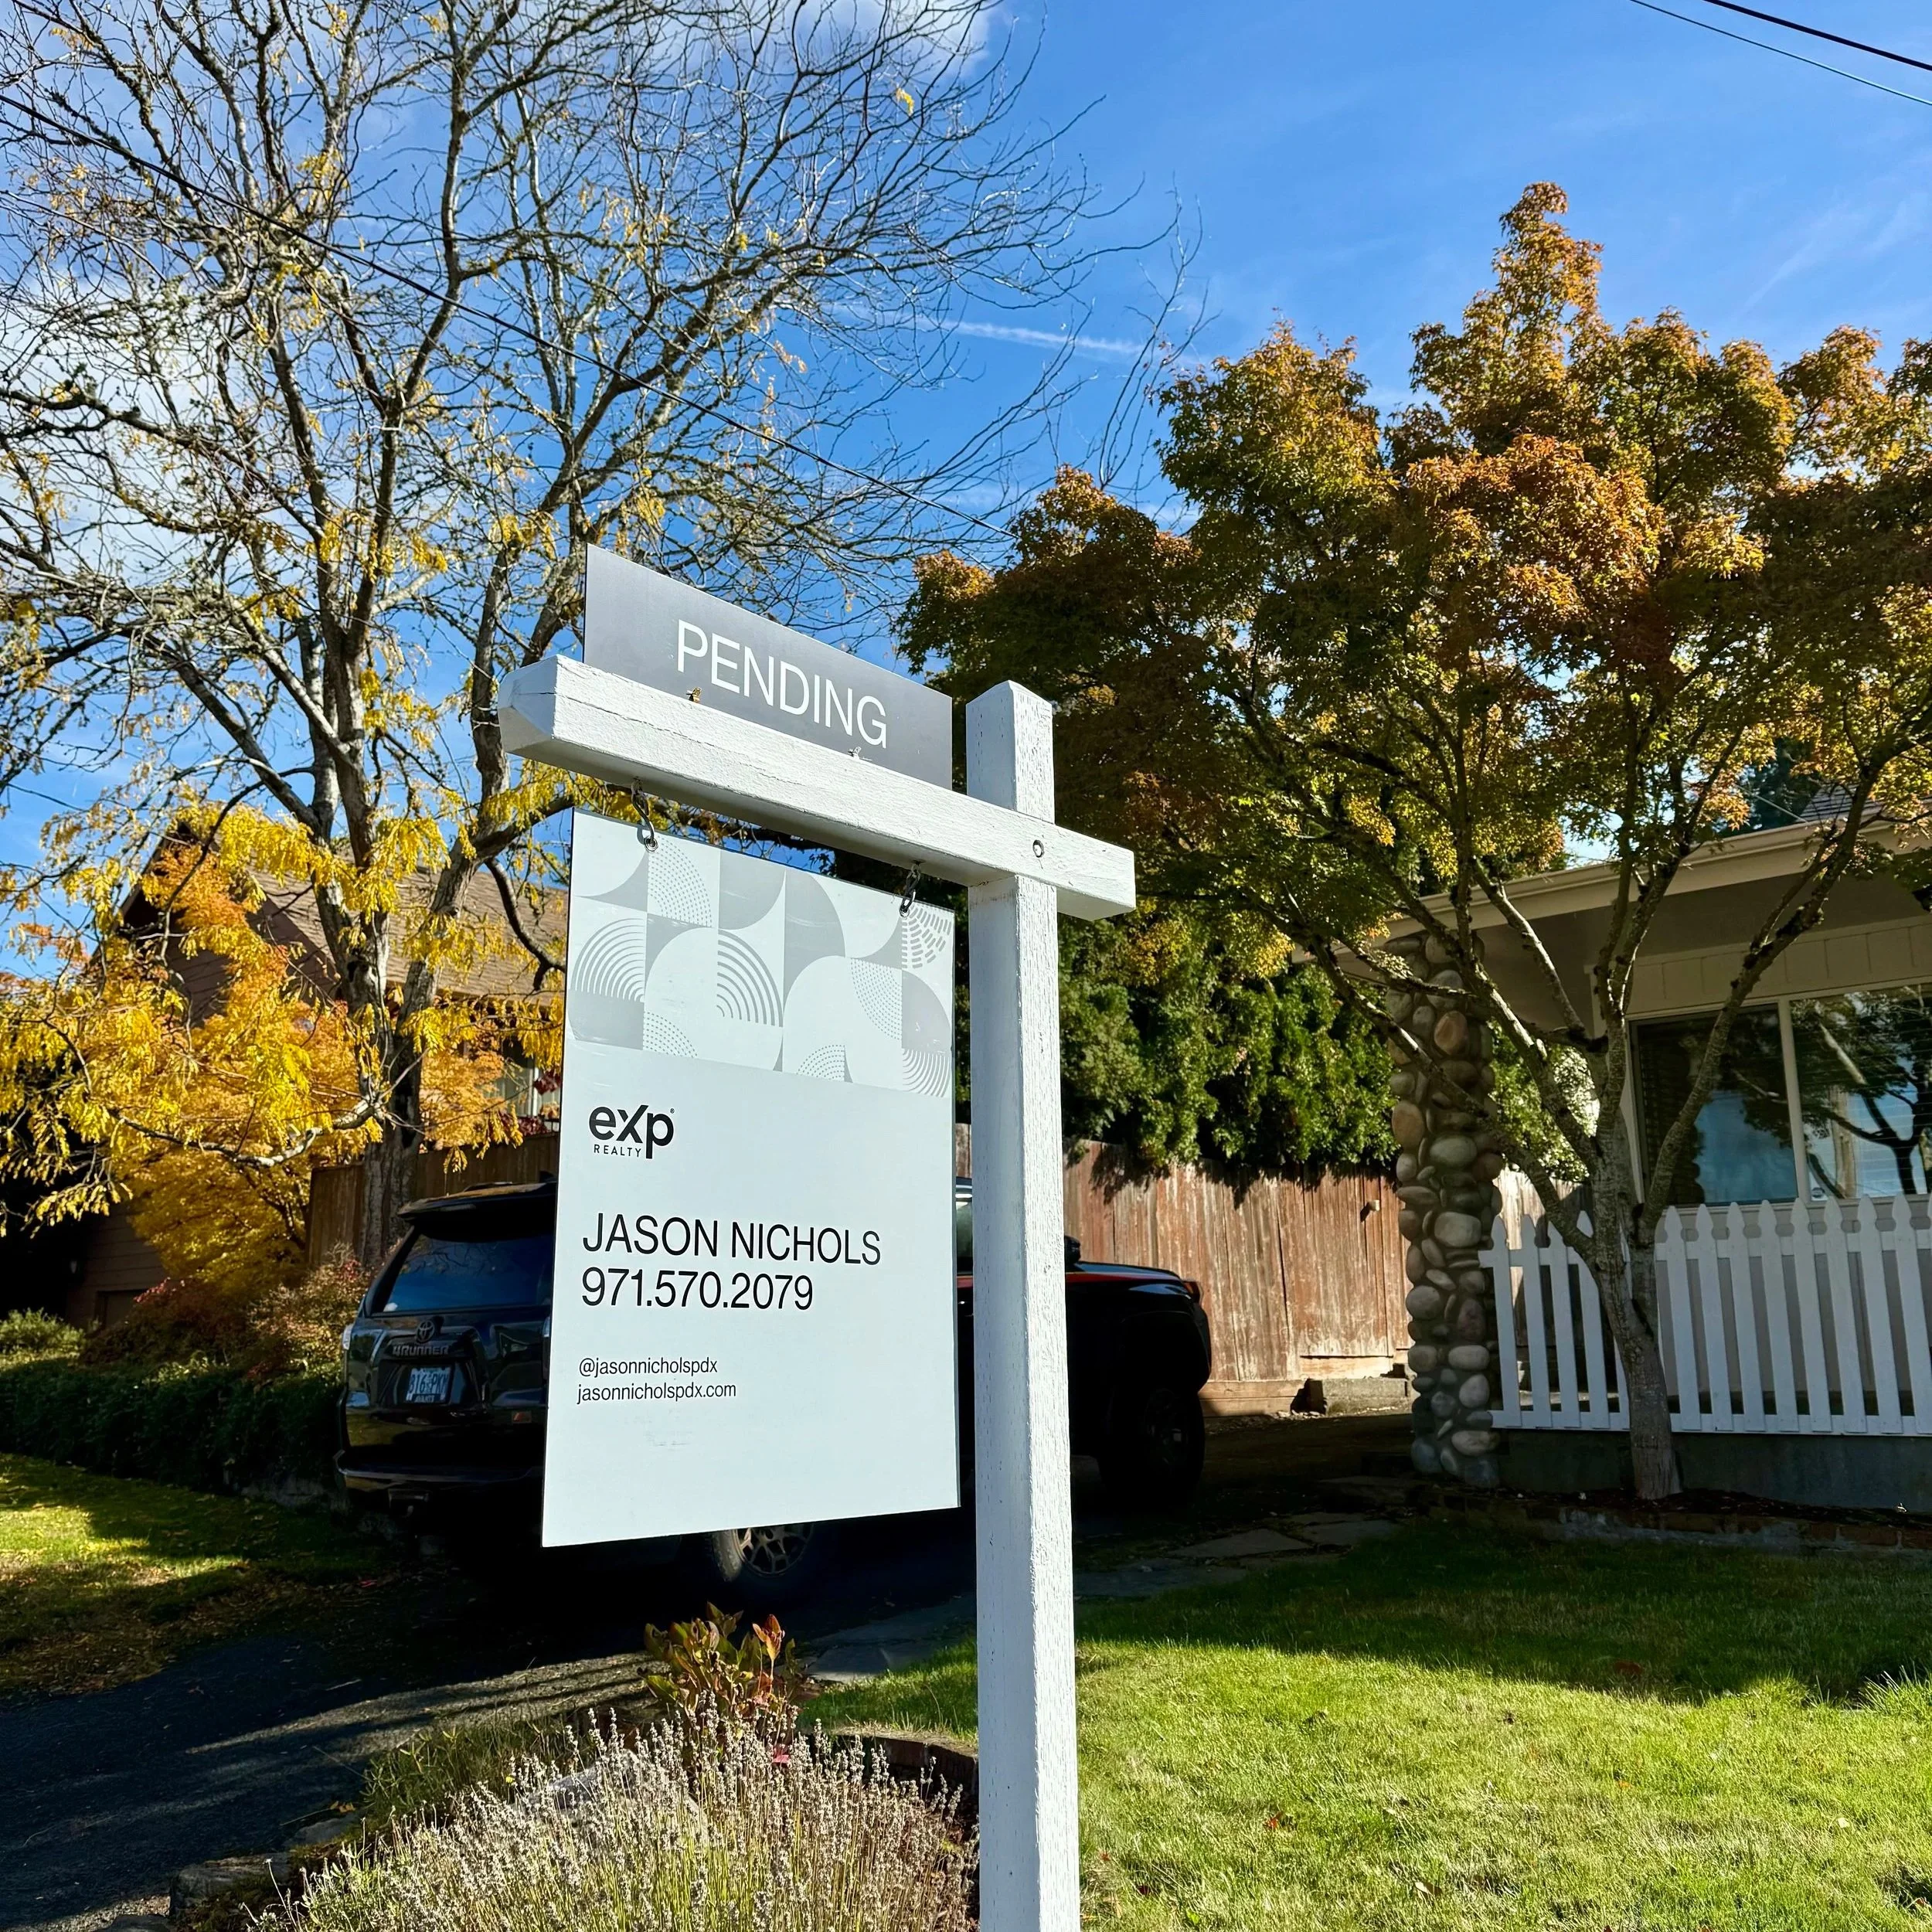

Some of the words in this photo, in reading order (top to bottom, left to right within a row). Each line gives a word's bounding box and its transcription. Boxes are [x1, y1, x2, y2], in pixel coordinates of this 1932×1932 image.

[676, 618, 887, 750] PENDING
[594, 1144, 641, 1158] REALTY
[583, 1213, 718, 1257] JASON
[731, 1221, 881, 1266] NICHOLS
[582, 1267, 813, 1311] 971.570.2079
[579, 1357, 718, 1378] @jasonnicholspdx
[577, 1382, 736, 1405] jasonnicholspdx.com
